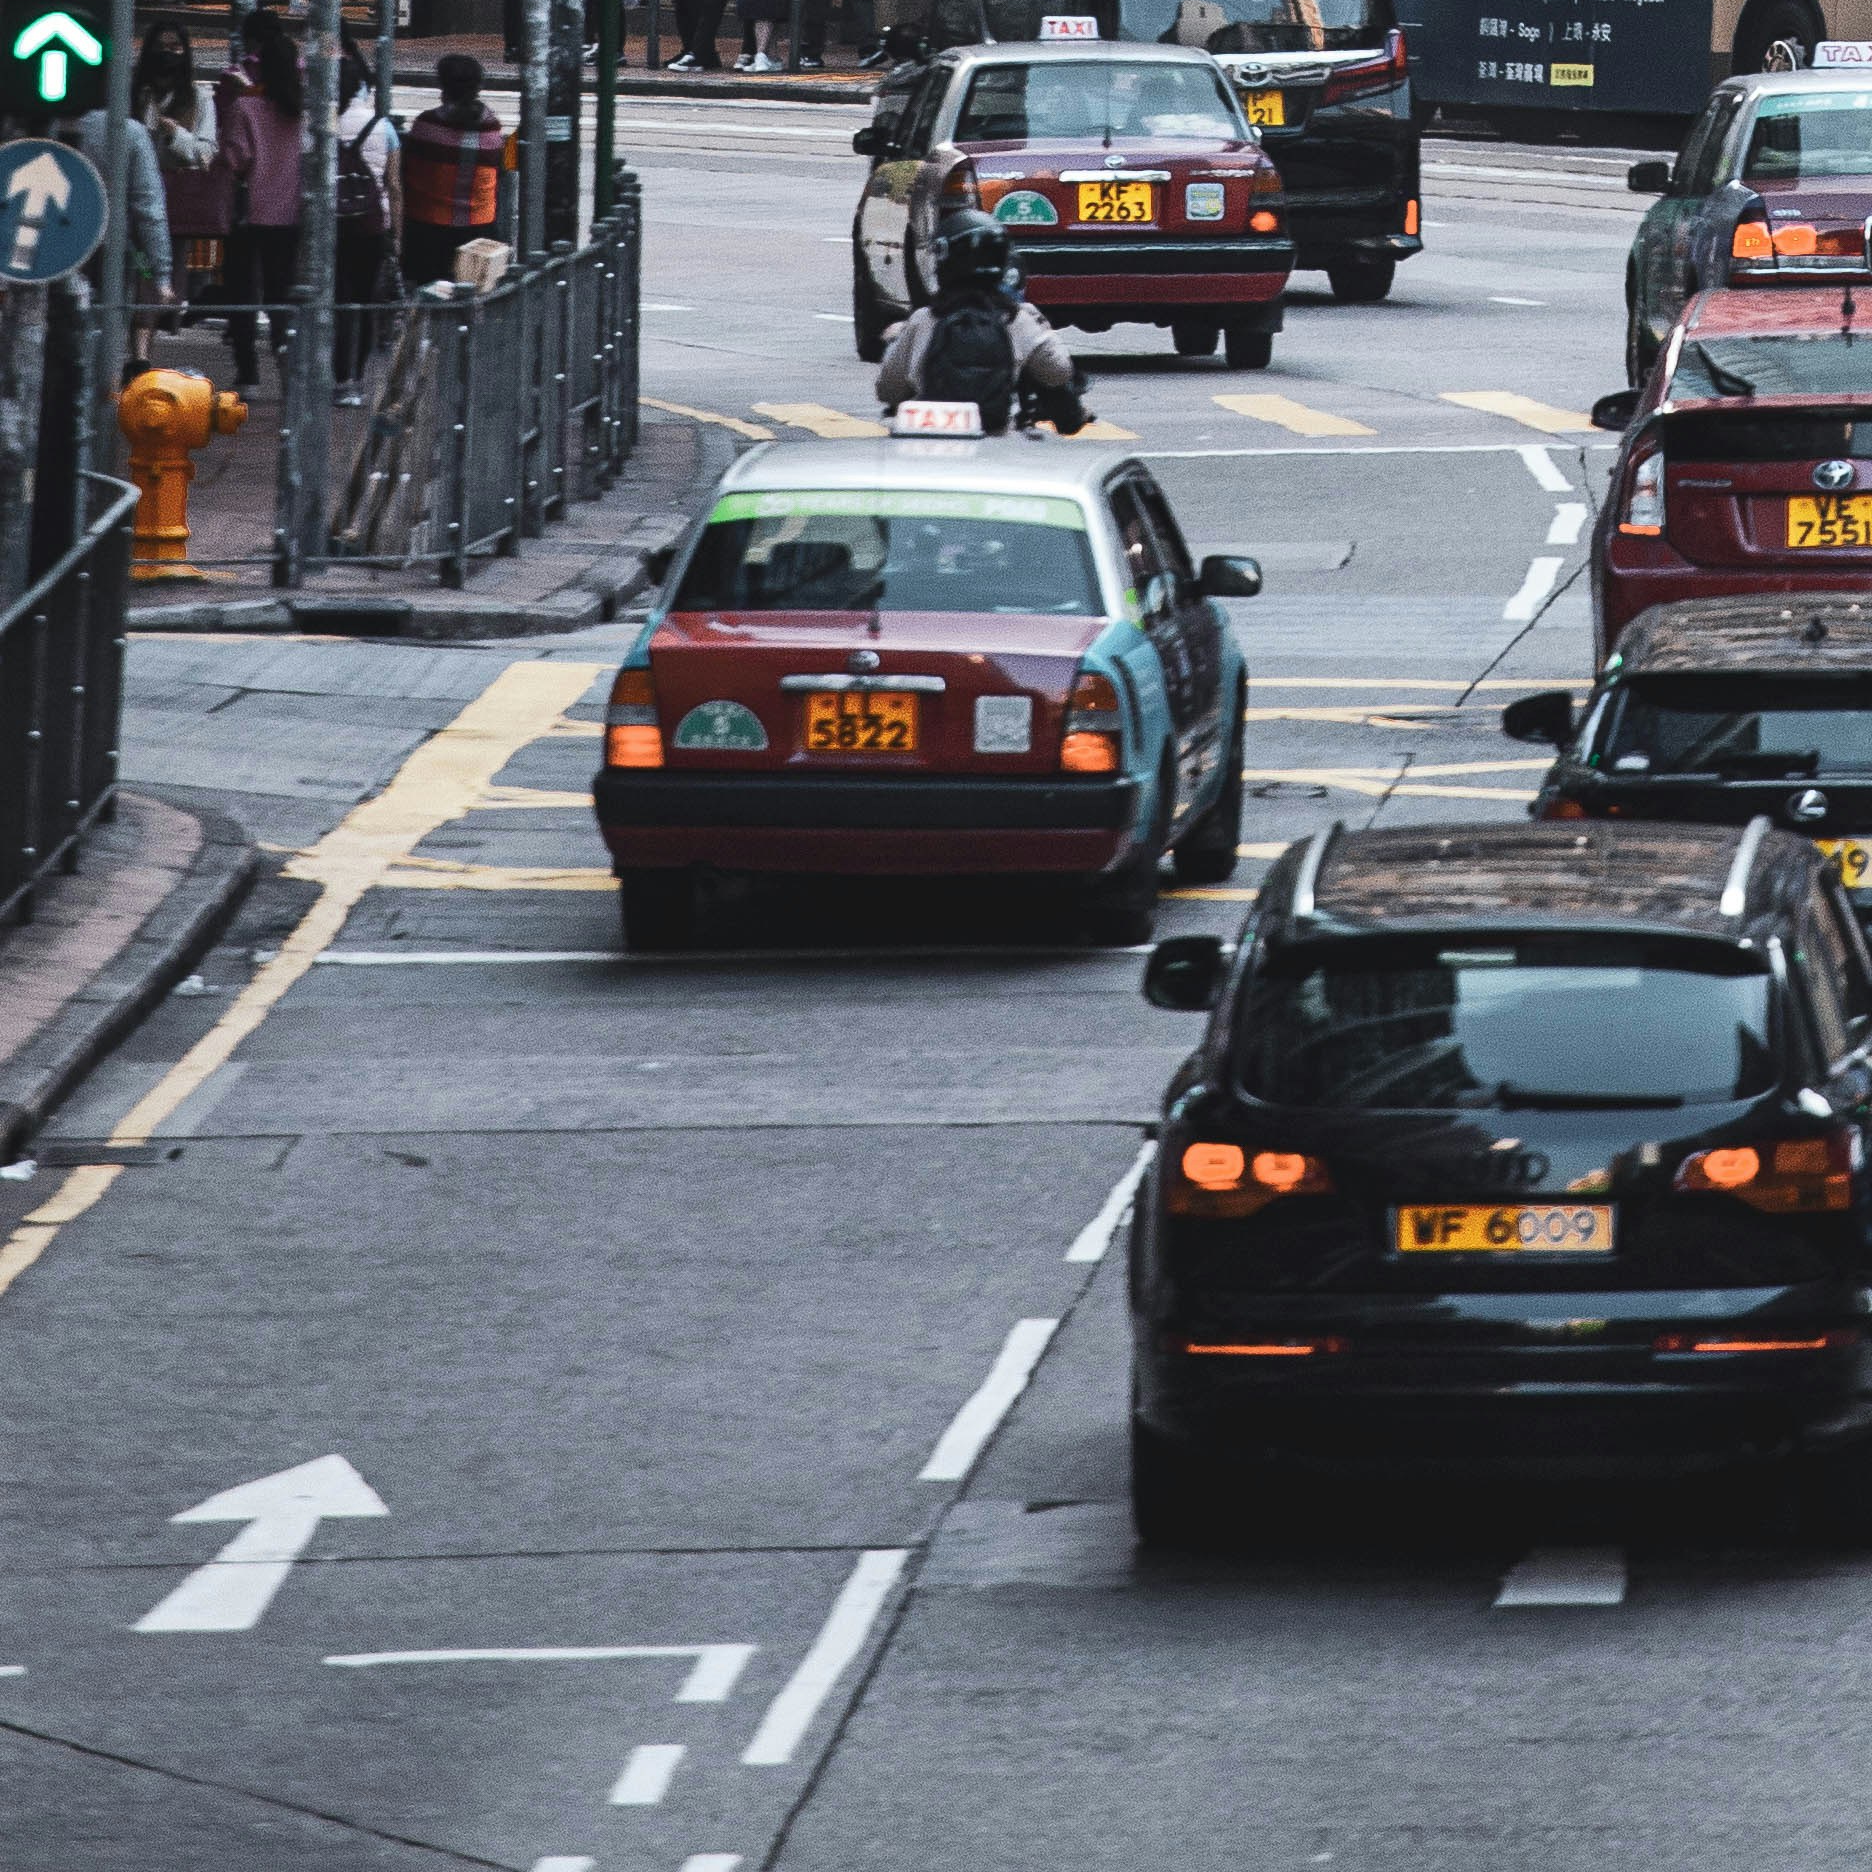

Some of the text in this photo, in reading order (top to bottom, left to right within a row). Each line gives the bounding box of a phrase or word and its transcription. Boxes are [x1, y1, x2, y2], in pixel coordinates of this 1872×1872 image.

[1046, 19, 1095, 40] TAXI
[1098, 182, 1130, 202] KF
[1084, 201, 1147, 222] 2263
[902, 406, 977, 432] TAXI
[1796, 520, 1872, 546] 7551
[812, 718, 910, 749] 5822
[1411, 1207, 1597, 1247] WF 6009
